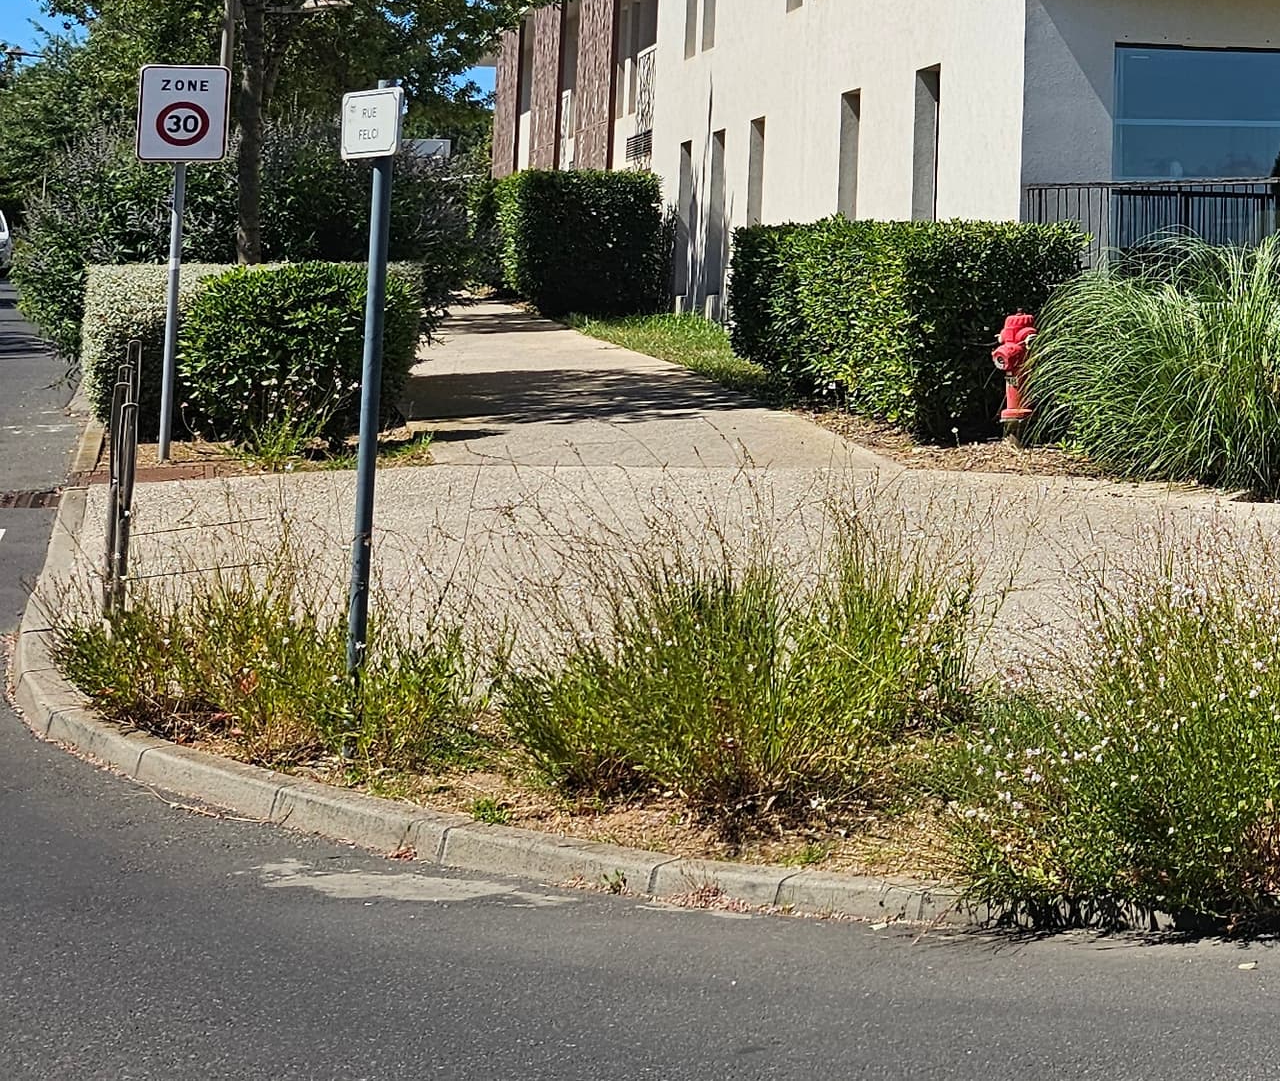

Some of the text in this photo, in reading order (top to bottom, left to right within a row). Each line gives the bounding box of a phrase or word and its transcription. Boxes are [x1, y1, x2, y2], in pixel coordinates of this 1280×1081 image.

[161, 79, 209, 92] ZONE
[360, 106, 377, 119] RUE
[166, 114, 199, 133] 30
